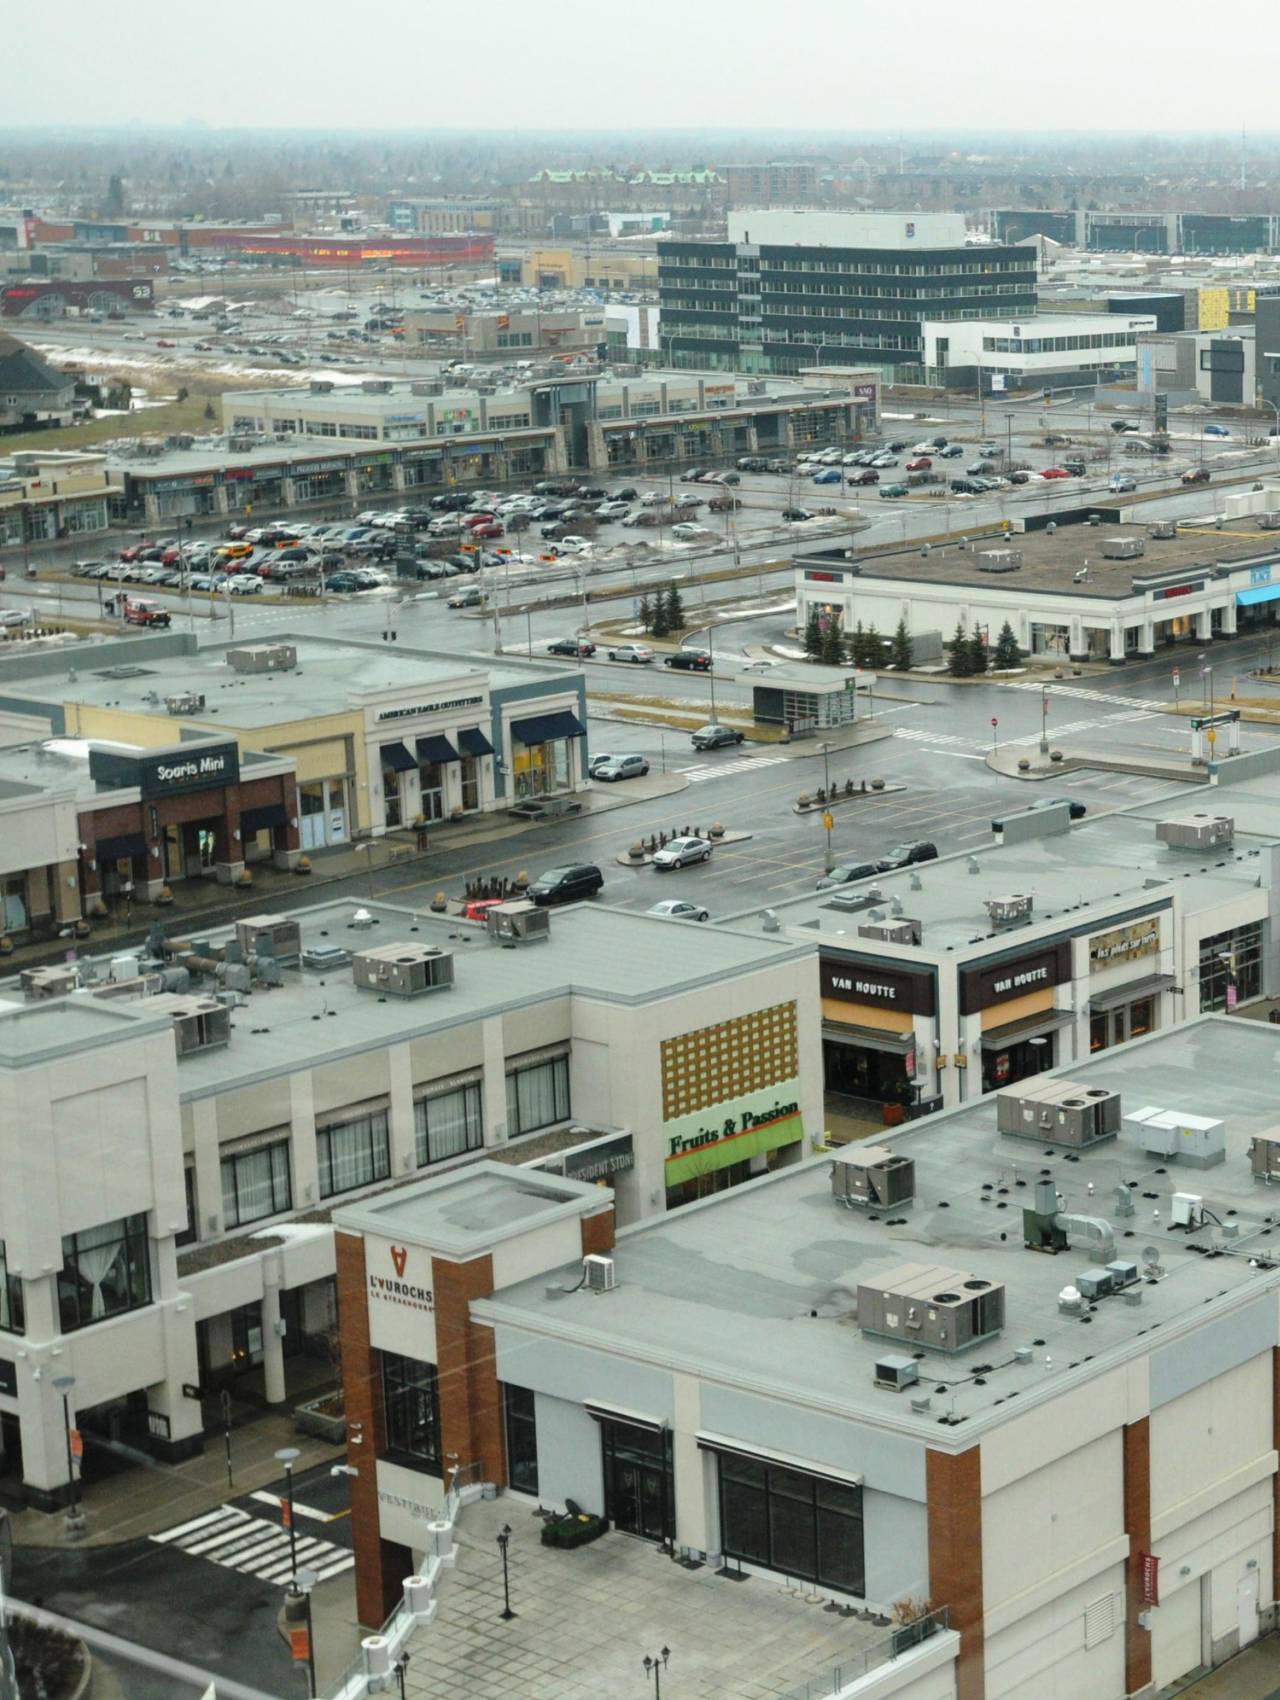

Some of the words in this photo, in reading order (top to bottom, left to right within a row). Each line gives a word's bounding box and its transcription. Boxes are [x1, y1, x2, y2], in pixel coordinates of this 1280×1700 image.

[379, 707, 417, 720] AMERICAN
[417, 703, 440, 715] EAGLE
[440, 696, 483, 709] OUTFITTERS
[200, 756, 225, 773] Mini
[832, 976, 852, 990] VAN
[856, 981, 896, 998] HOUTTE
[994, 978, 1011, 993] VAN
[1014, 967, 1048, 986] HOUTTE
[669, 1127, 720, 1156] Fruits
[723, 1118, 737, 1137] &
[741, 1101, 799, 1131] Passion
